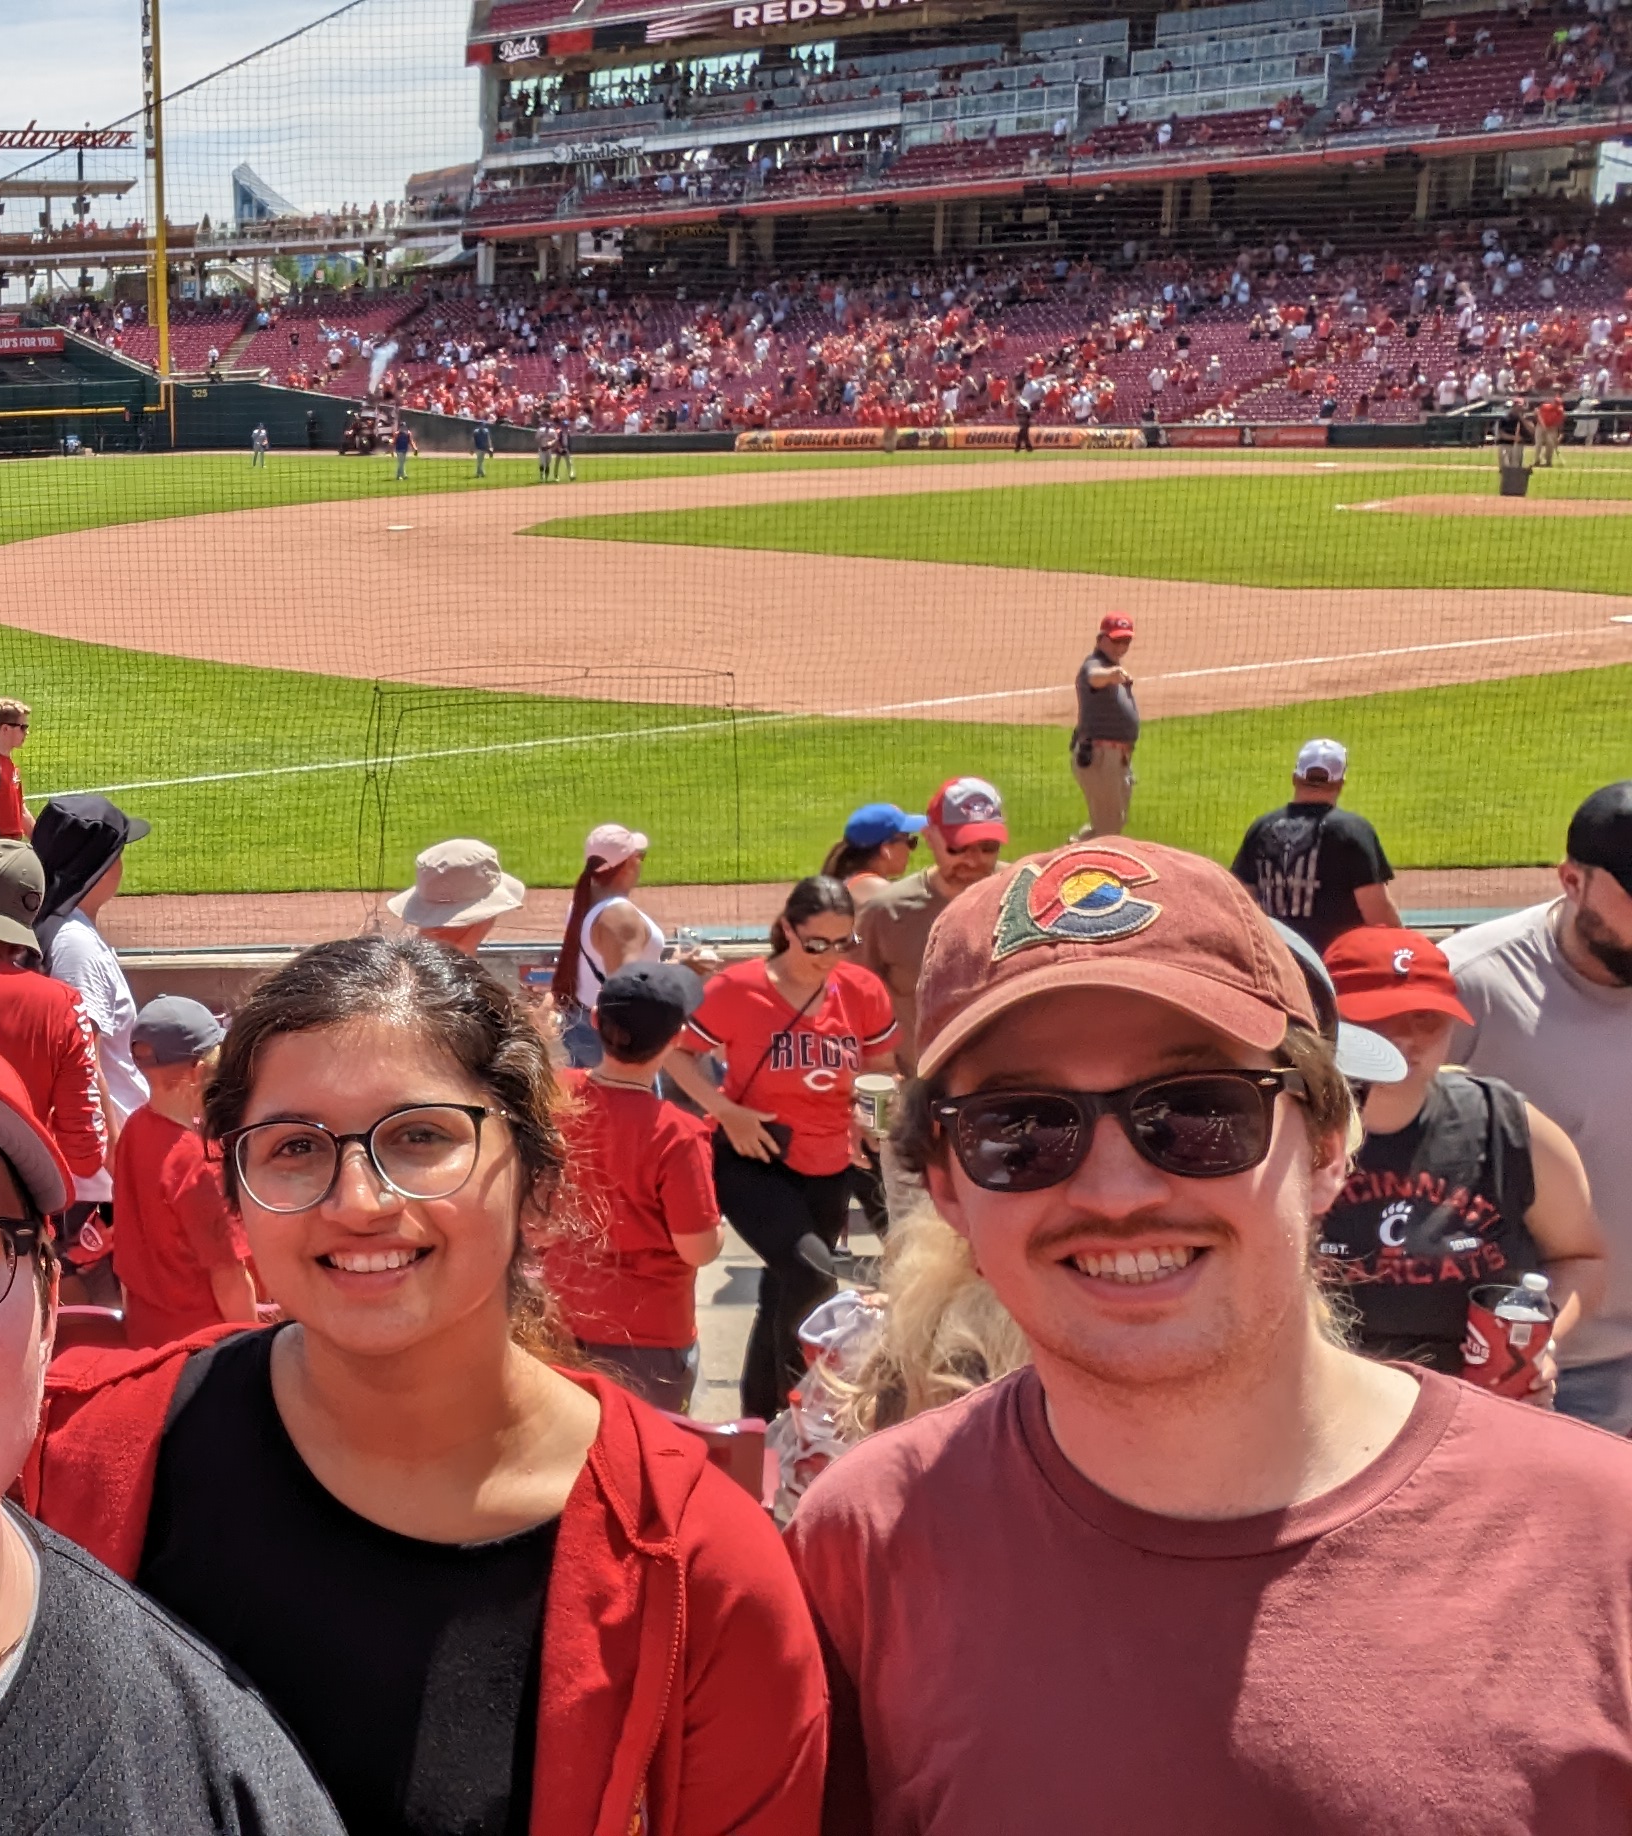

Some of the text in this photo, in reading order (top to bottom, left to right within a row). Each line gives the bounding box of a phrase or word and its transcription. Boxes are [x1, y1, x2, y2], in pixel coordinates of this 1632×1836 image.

[733, 0, 846, 28] REDS
[499, 36, 540, 62] Reds
[571, 145, 643, 162] handlebar
[19, 337, 36, 347] FOR
[38, 336, 57, 346] YOU.
[192, 389, 208, 398] 325
[770, 1032, 859, 1072] REDS
[1319, 1243, 1350, 1255] EST.
